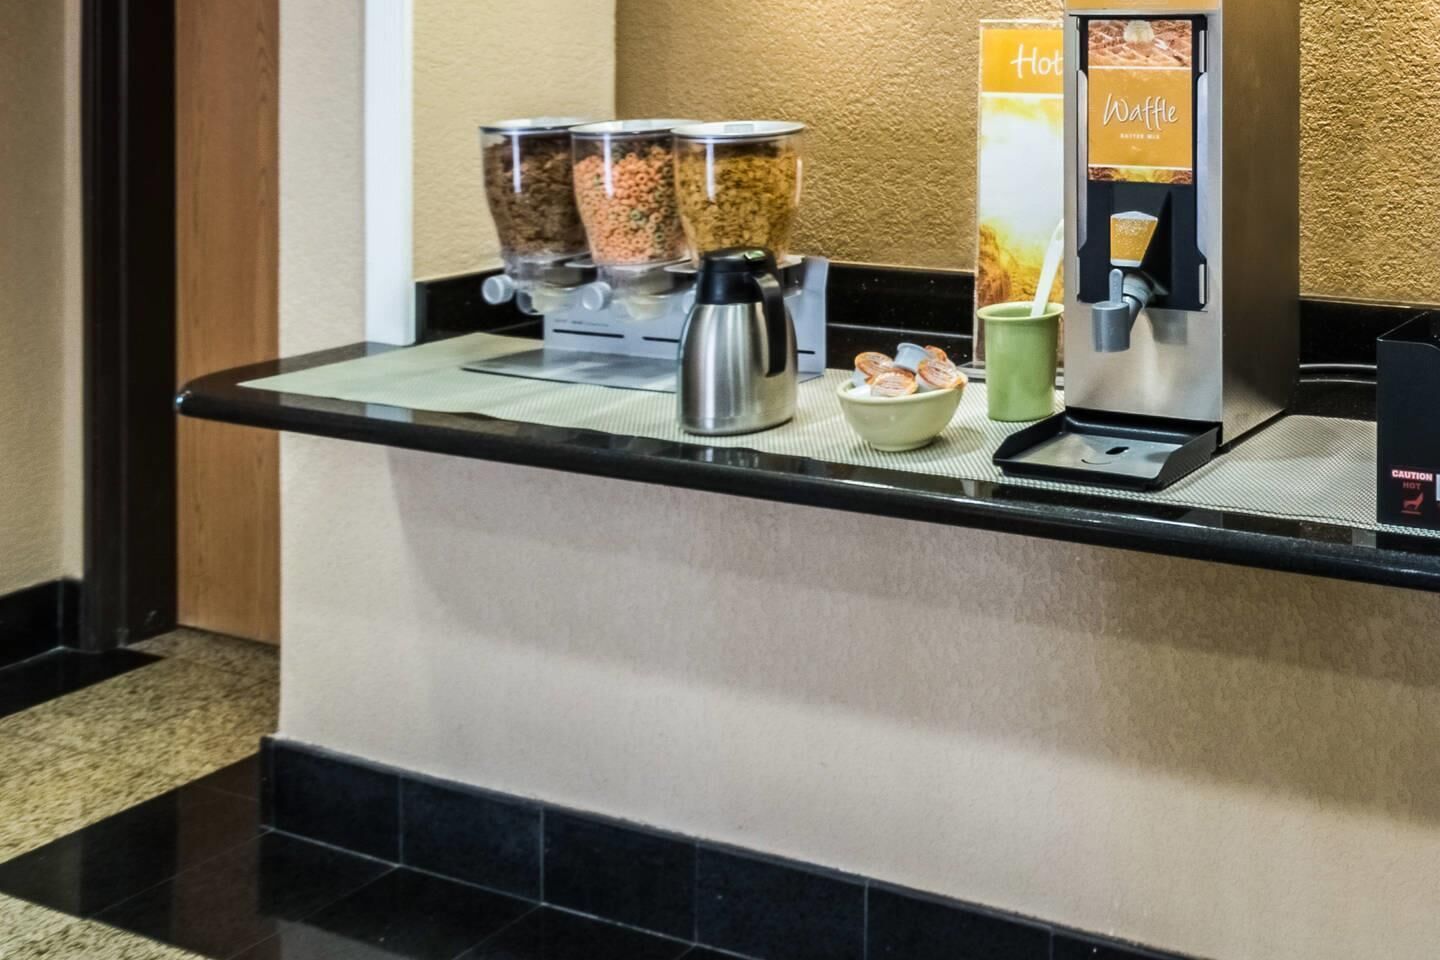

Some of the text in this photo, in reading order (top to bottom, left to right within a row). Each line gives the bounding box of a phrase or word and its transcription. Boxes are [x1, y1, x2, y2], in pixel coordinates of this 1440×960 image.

[1010, 44, 1063, 79] Hot
[1103, 93, 1178, 131] Waffle
[1391, 469, 1433, 482] CAUTION
[1402, 482, 1422, 490] HOT
